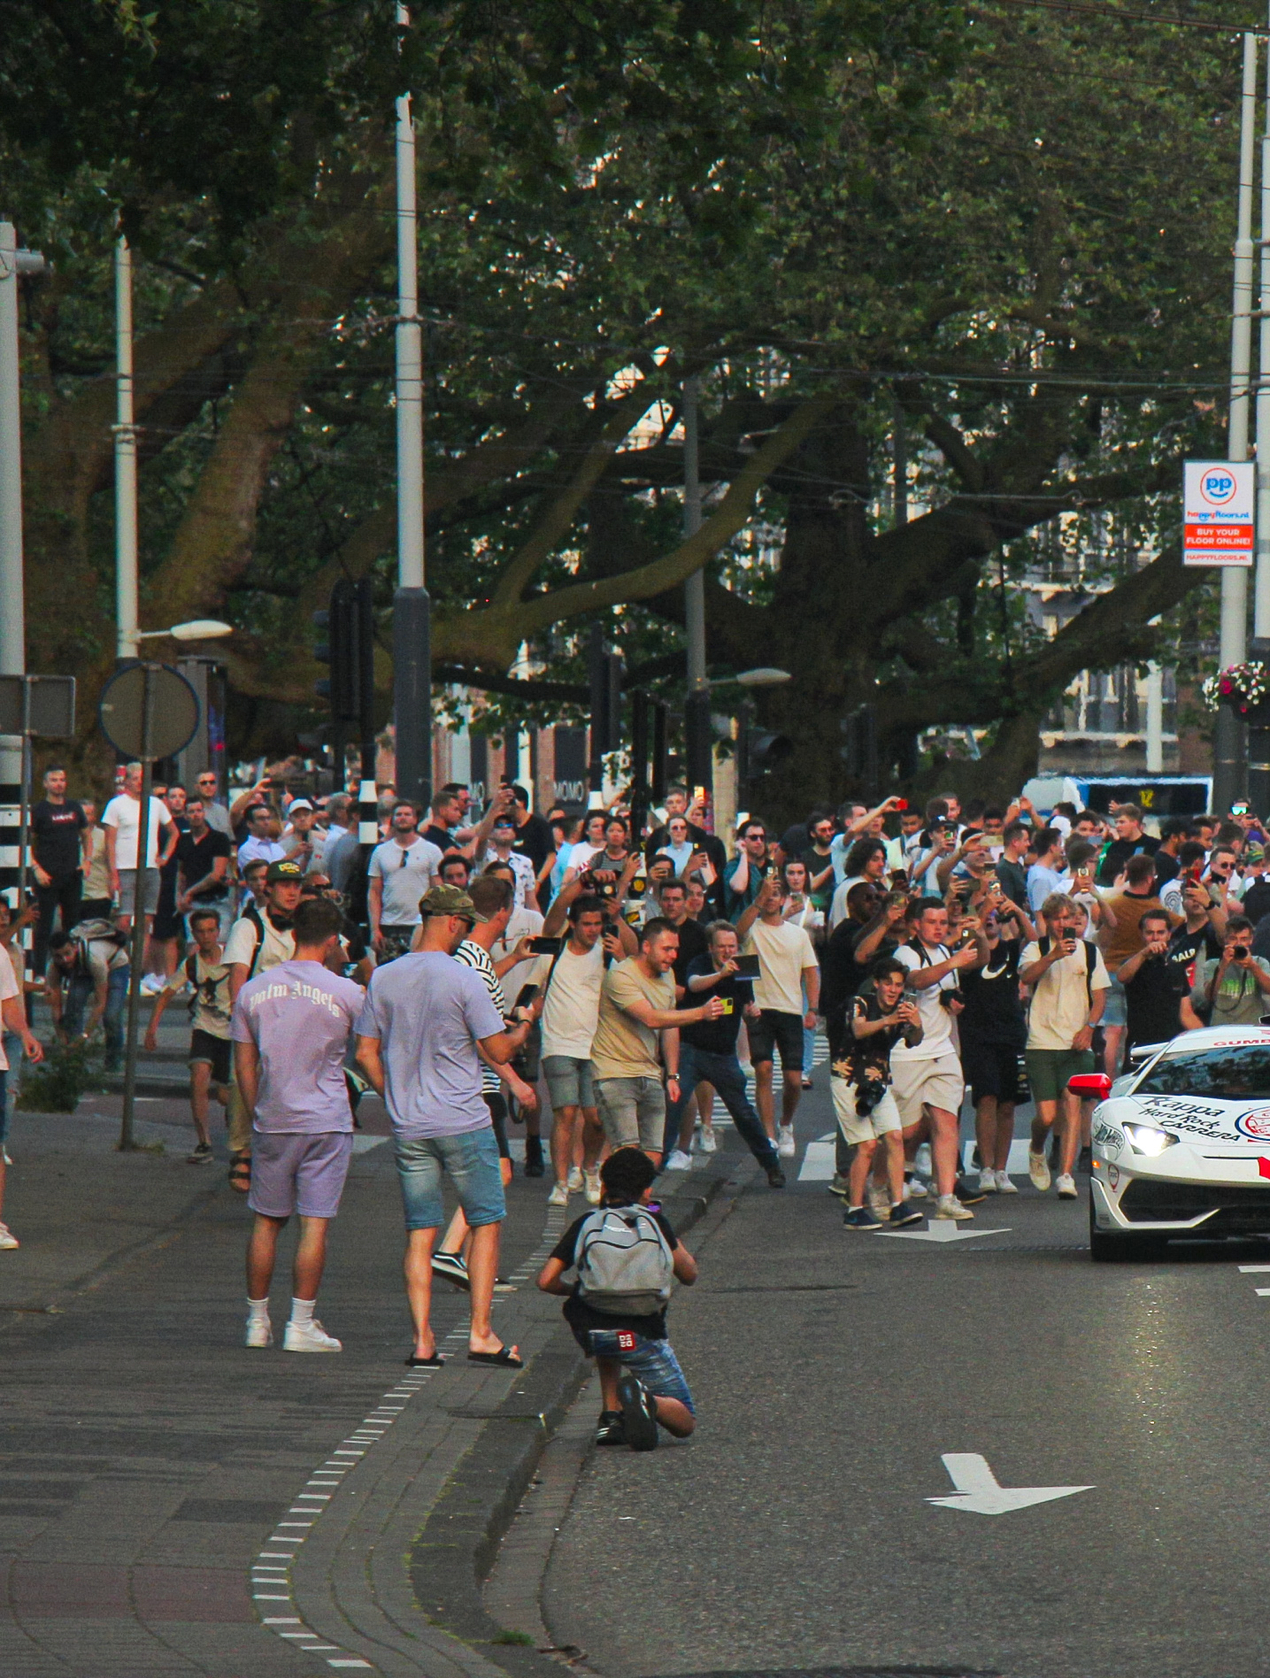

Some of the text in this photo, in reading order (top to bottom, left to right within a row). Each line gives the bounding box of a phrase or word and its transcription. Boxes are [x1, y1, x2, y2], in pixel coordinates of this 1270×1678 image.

[1187, 510, 1249, 521] happyfloors.nl
[1186, 537, 1215, 545] FLOOR
[1197, 528, 1214, 536] BUY
[291, 980, 340, 1018] Angels
[1144, 1097, 1226, 1117] Kappa
[1138, 1108, 1221, 1130] Hard Rock
[1160, 1120, 1241, 1142] CARRERA
